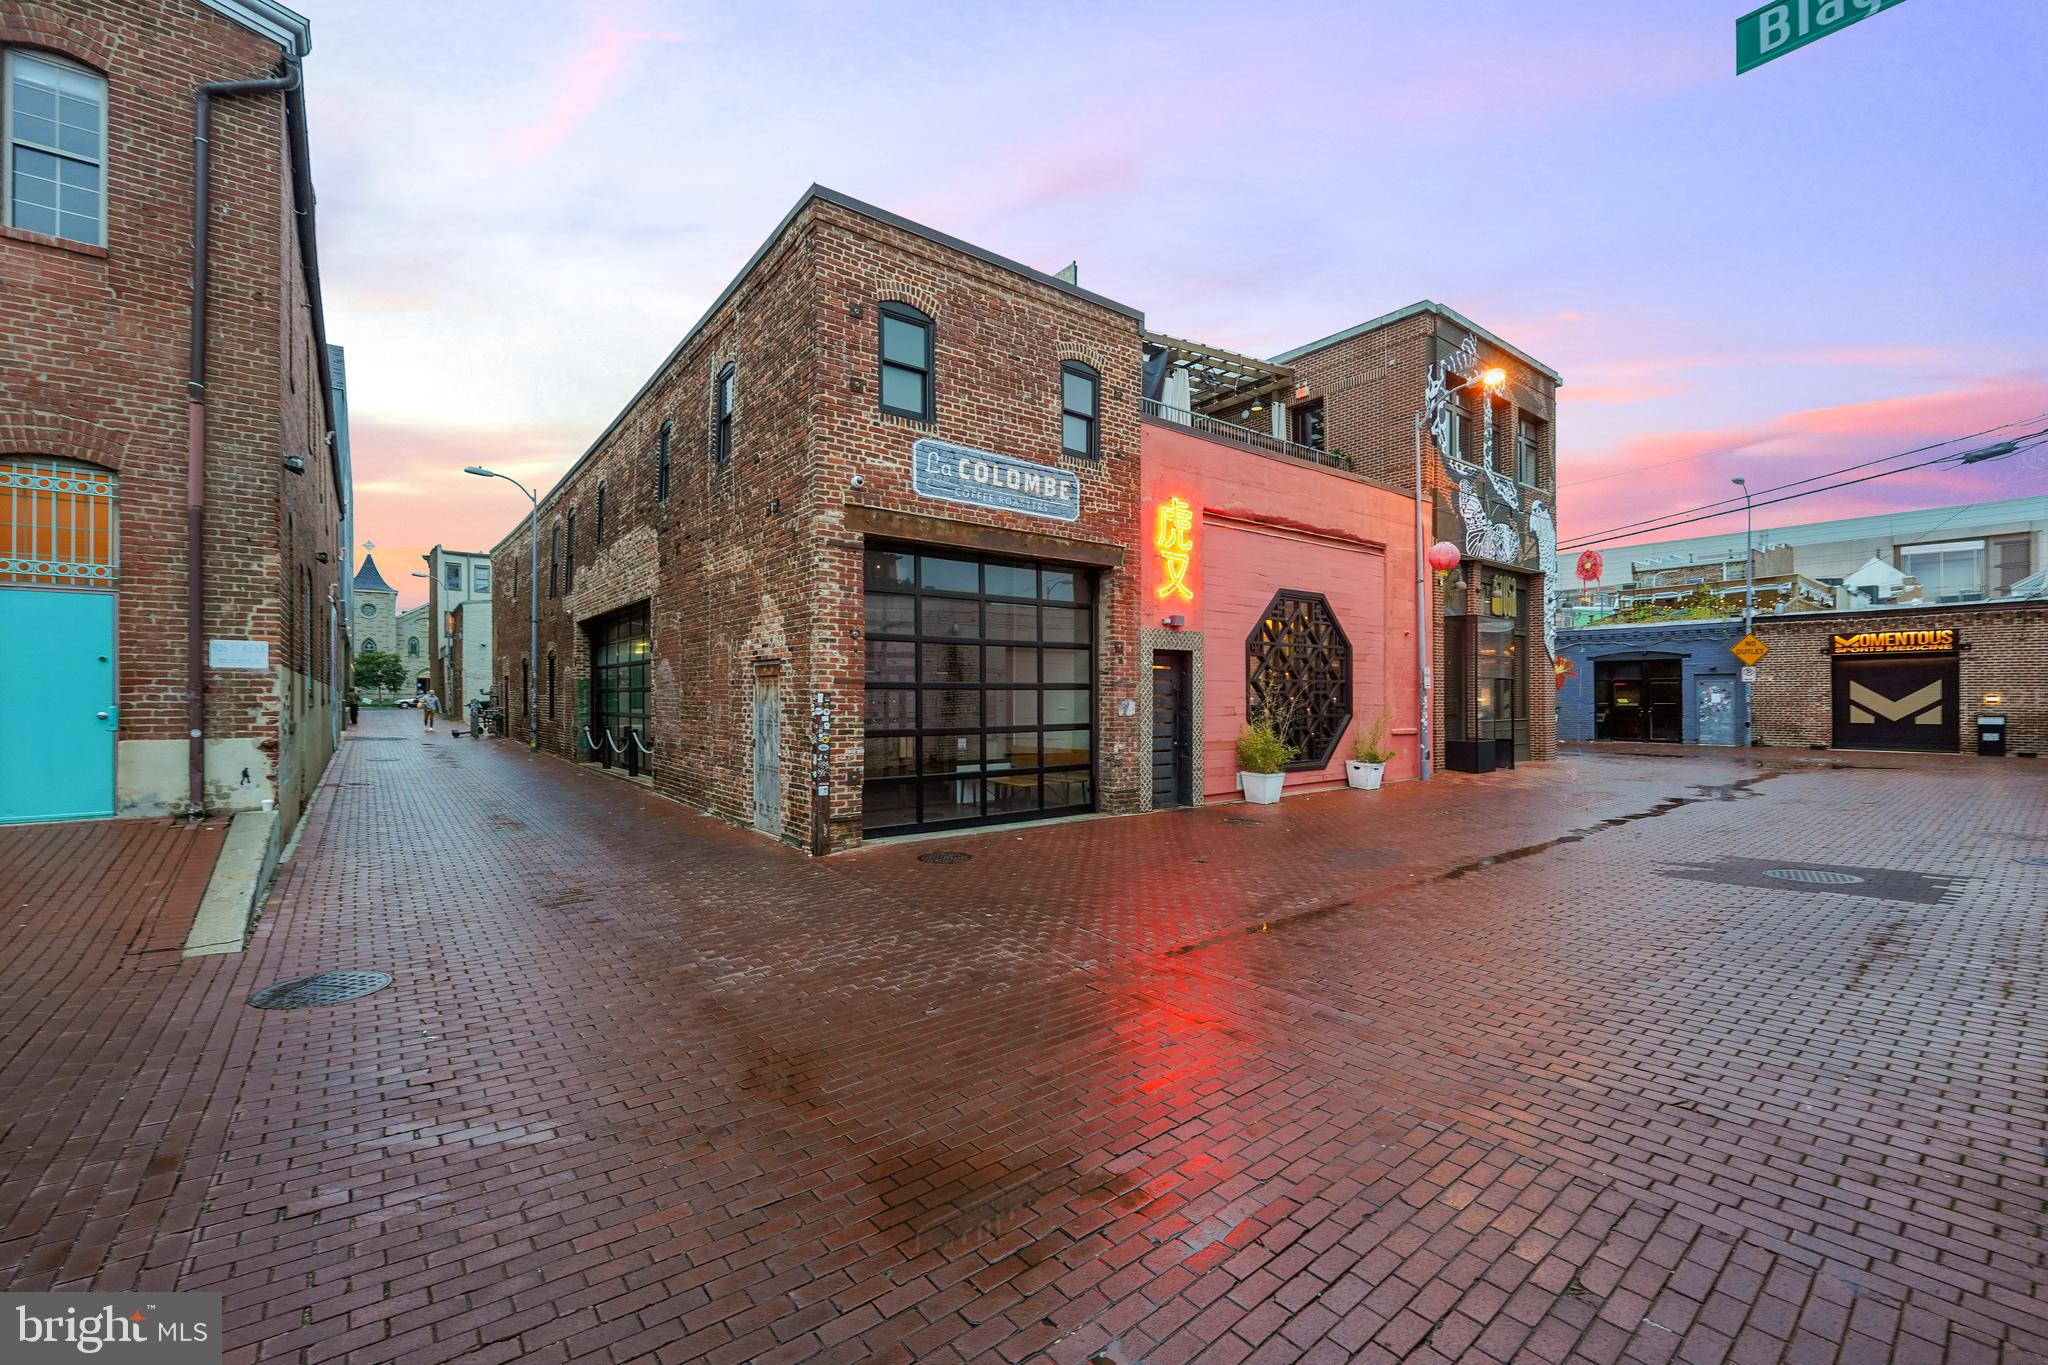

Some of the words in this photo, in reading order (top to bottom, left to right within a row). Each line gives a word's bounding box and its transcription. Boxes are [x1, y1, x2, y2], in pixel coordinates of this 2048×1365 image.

[925, 451, 953, 477] La
[957, 457, 1071, 501] COLOMBE
[954, 487, 994, 502] COFFEE
[998, 494, 1049, 512] ROASTERS
[1834, 630, 1953, 647] MOMENTOUS
